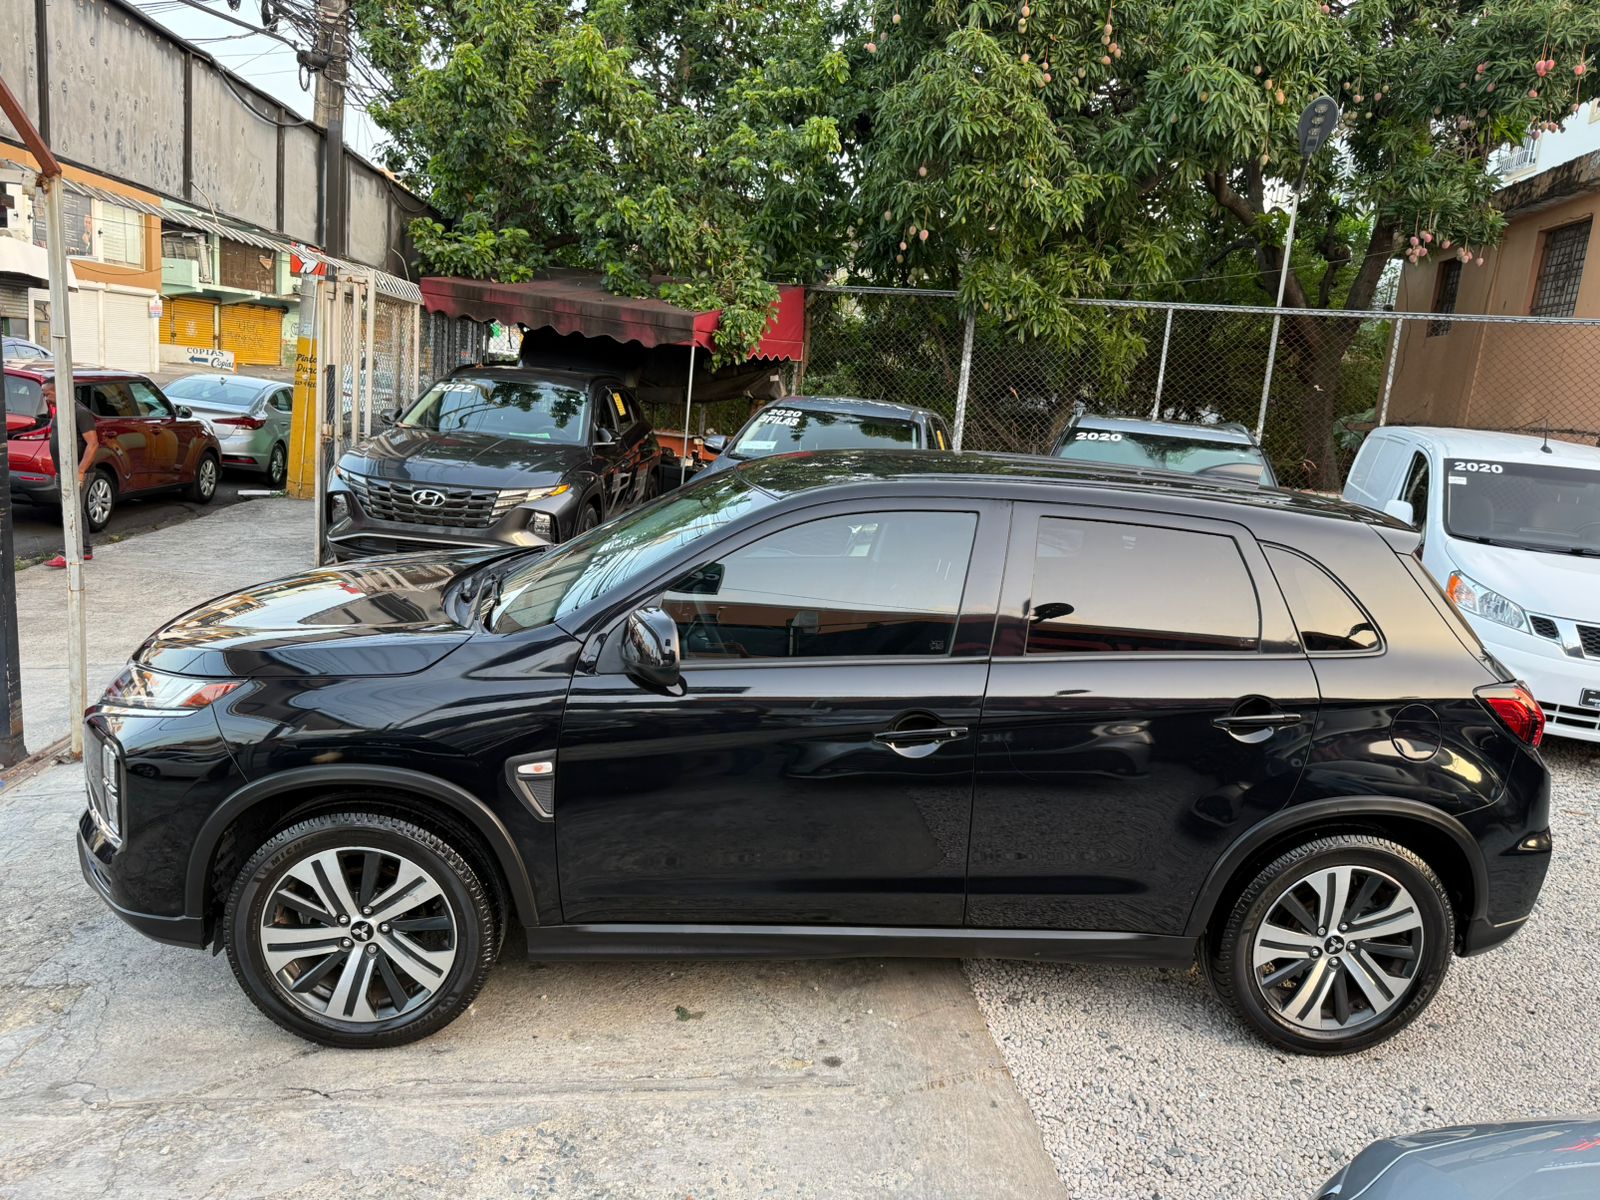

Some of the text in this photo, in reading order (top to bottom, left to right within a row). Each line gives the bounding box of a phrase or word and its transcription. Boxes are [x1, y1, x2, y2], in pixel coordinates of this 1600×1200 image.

[187, 347, 224, 357] COPIAS
[431, 382, 476, 393] 2022
[767, 408, 803, 418] 2020
[1075, 431, 1122, 442] 2020
[1453, 461, 1504, 474] 2020
